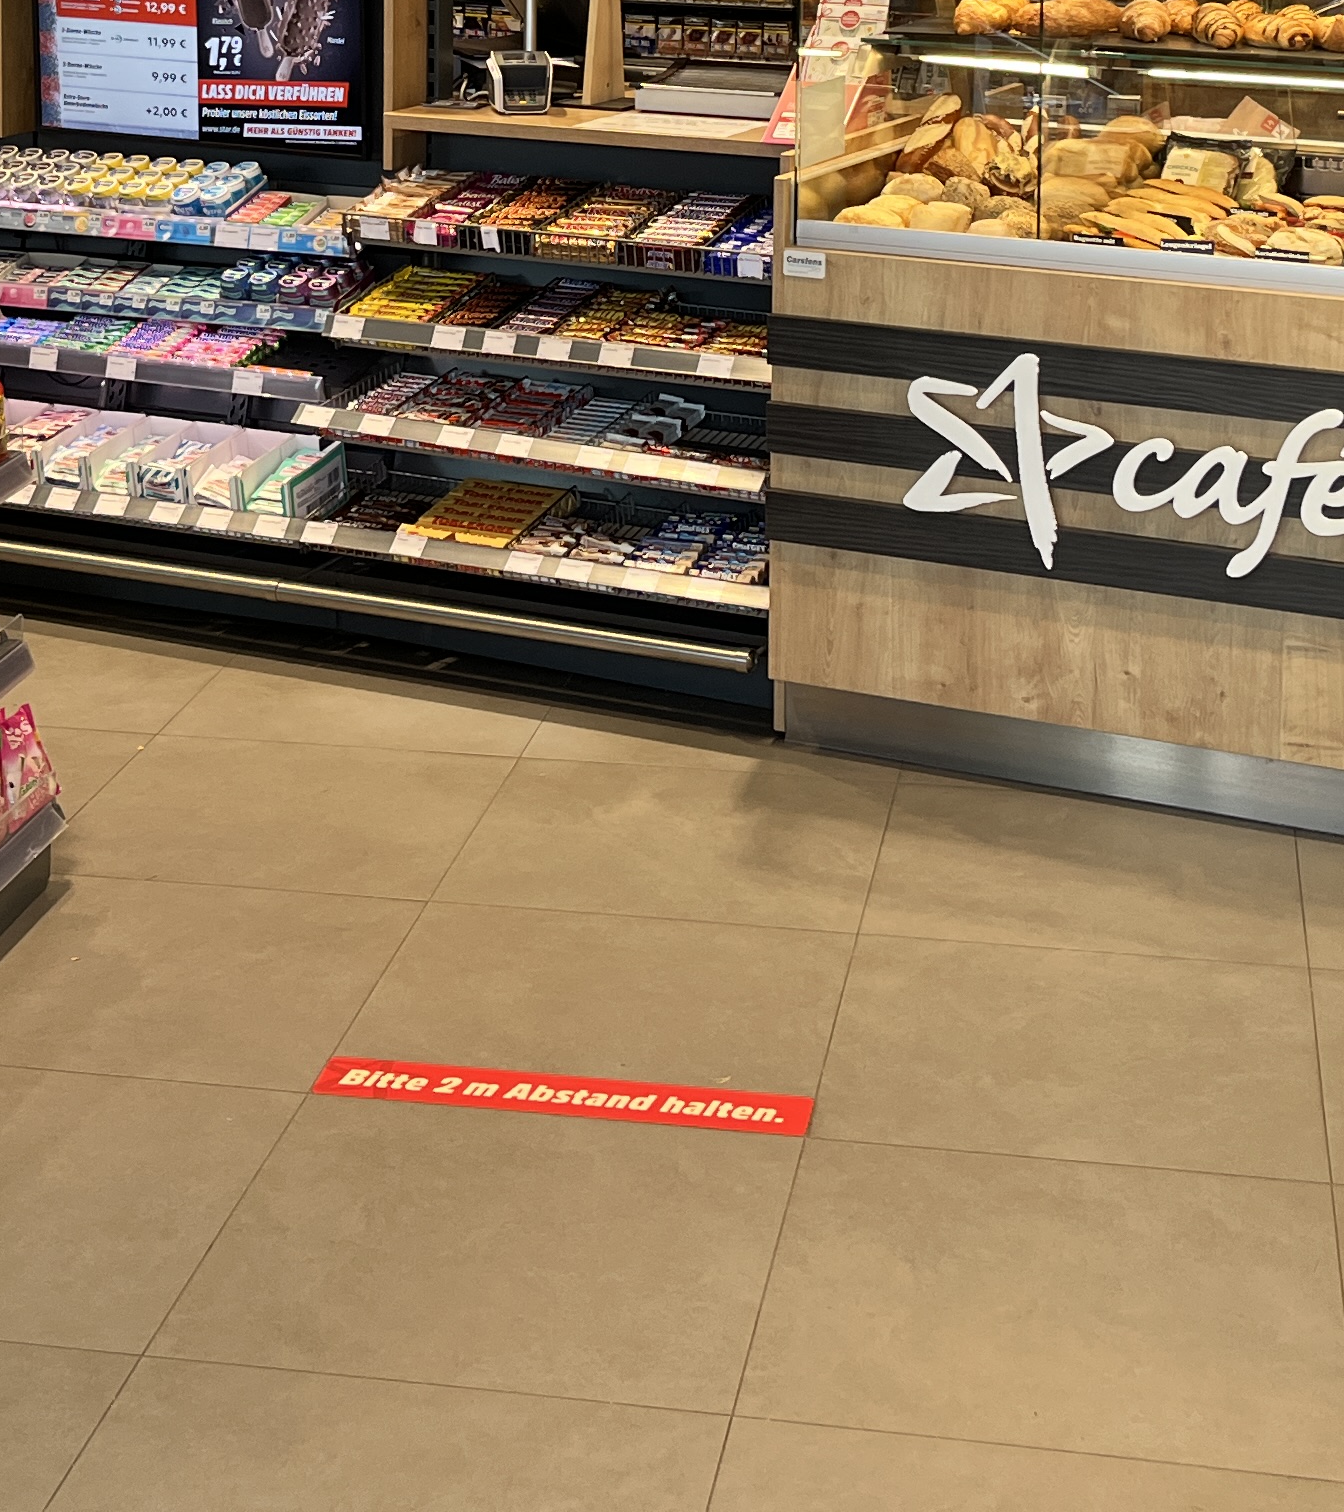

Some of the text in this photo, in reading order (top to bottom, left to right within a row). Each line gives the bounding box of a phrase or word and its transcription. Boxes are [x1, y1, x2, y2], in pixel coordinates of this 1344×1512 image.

[144, 1, 187, 15] 12,99 €
[147, 36, 187, 50] 11,99 €
[151, 71, 187, 84] 9,99 €
[202, 83, 345, 102] LASS DICH VERFÜHREN
[146, 106, 188, 118] +2,00 €
[201, 106, 230, 118] Probier
[231, 108, 257, 119] unsere
[246, 126, 269, 135] MEHR
[270, 127, 286, 136] ALS
[287, 126, 321, 137] GÜNSTIG
[322, 128, 357, 138] TANKEN!
[338, 1068, 785, 1125] Bitte 2 m Abstand halten.
